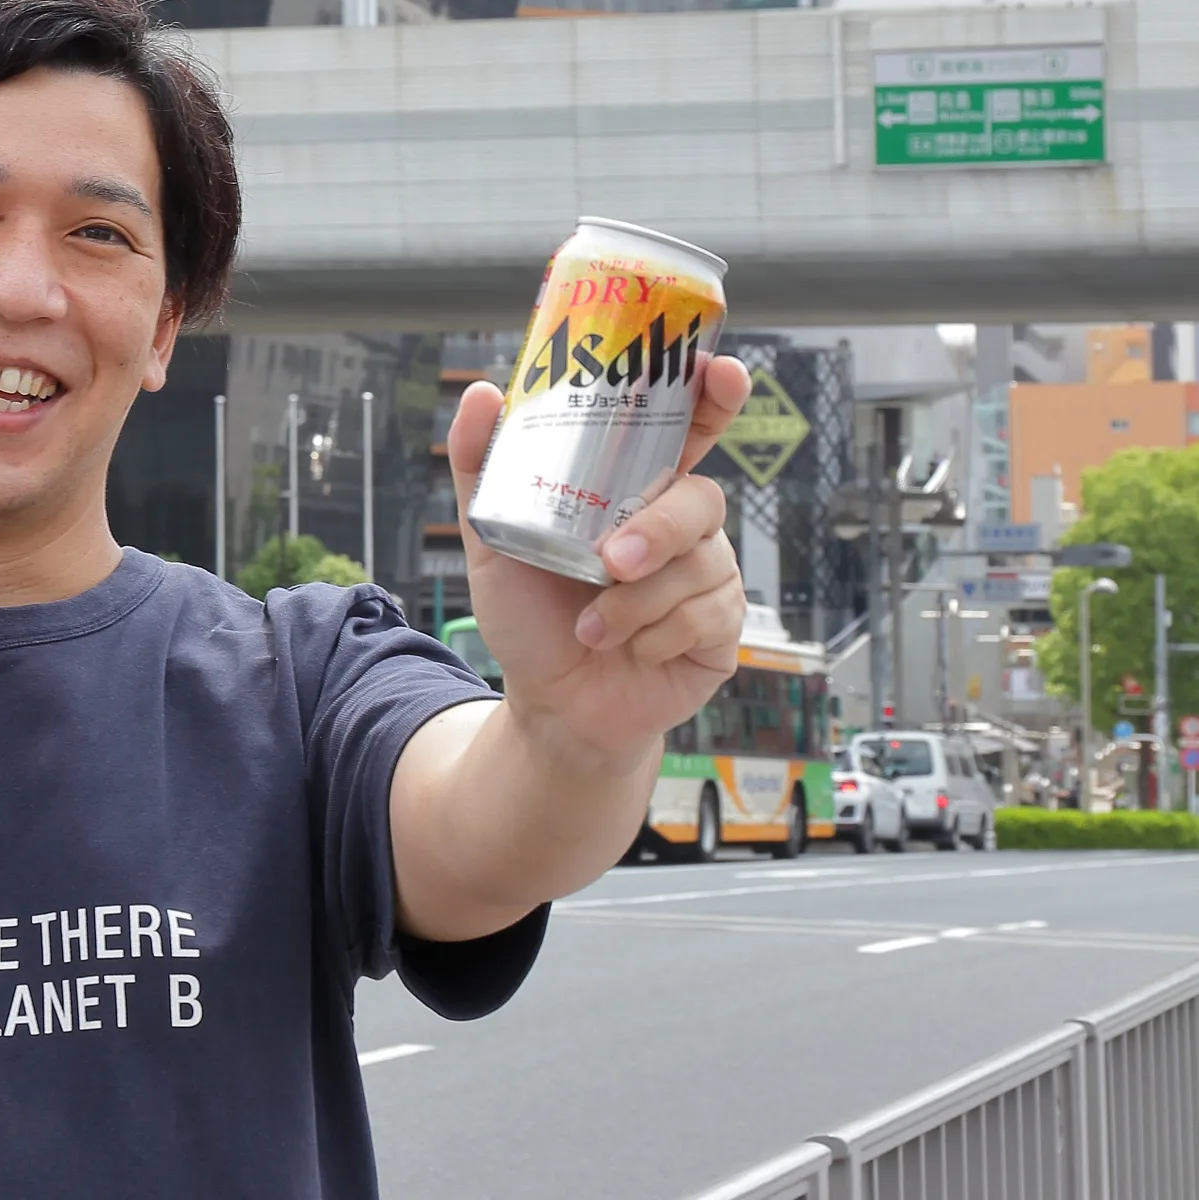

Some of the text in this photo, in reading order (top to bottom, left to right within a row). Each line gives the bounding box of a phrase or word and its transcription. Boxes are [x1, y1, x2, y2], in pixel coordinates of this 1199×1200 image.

[587, 259, 645, 273] SUPER
[523, 311, 702, 395] Asahi
[567, 393, 649, 408] 生ジョッキ缶
[530, 474, 612, 512] スーパードライ
[31, 904, 201, 967] THERE
[168, 973, 204, 1029] B
